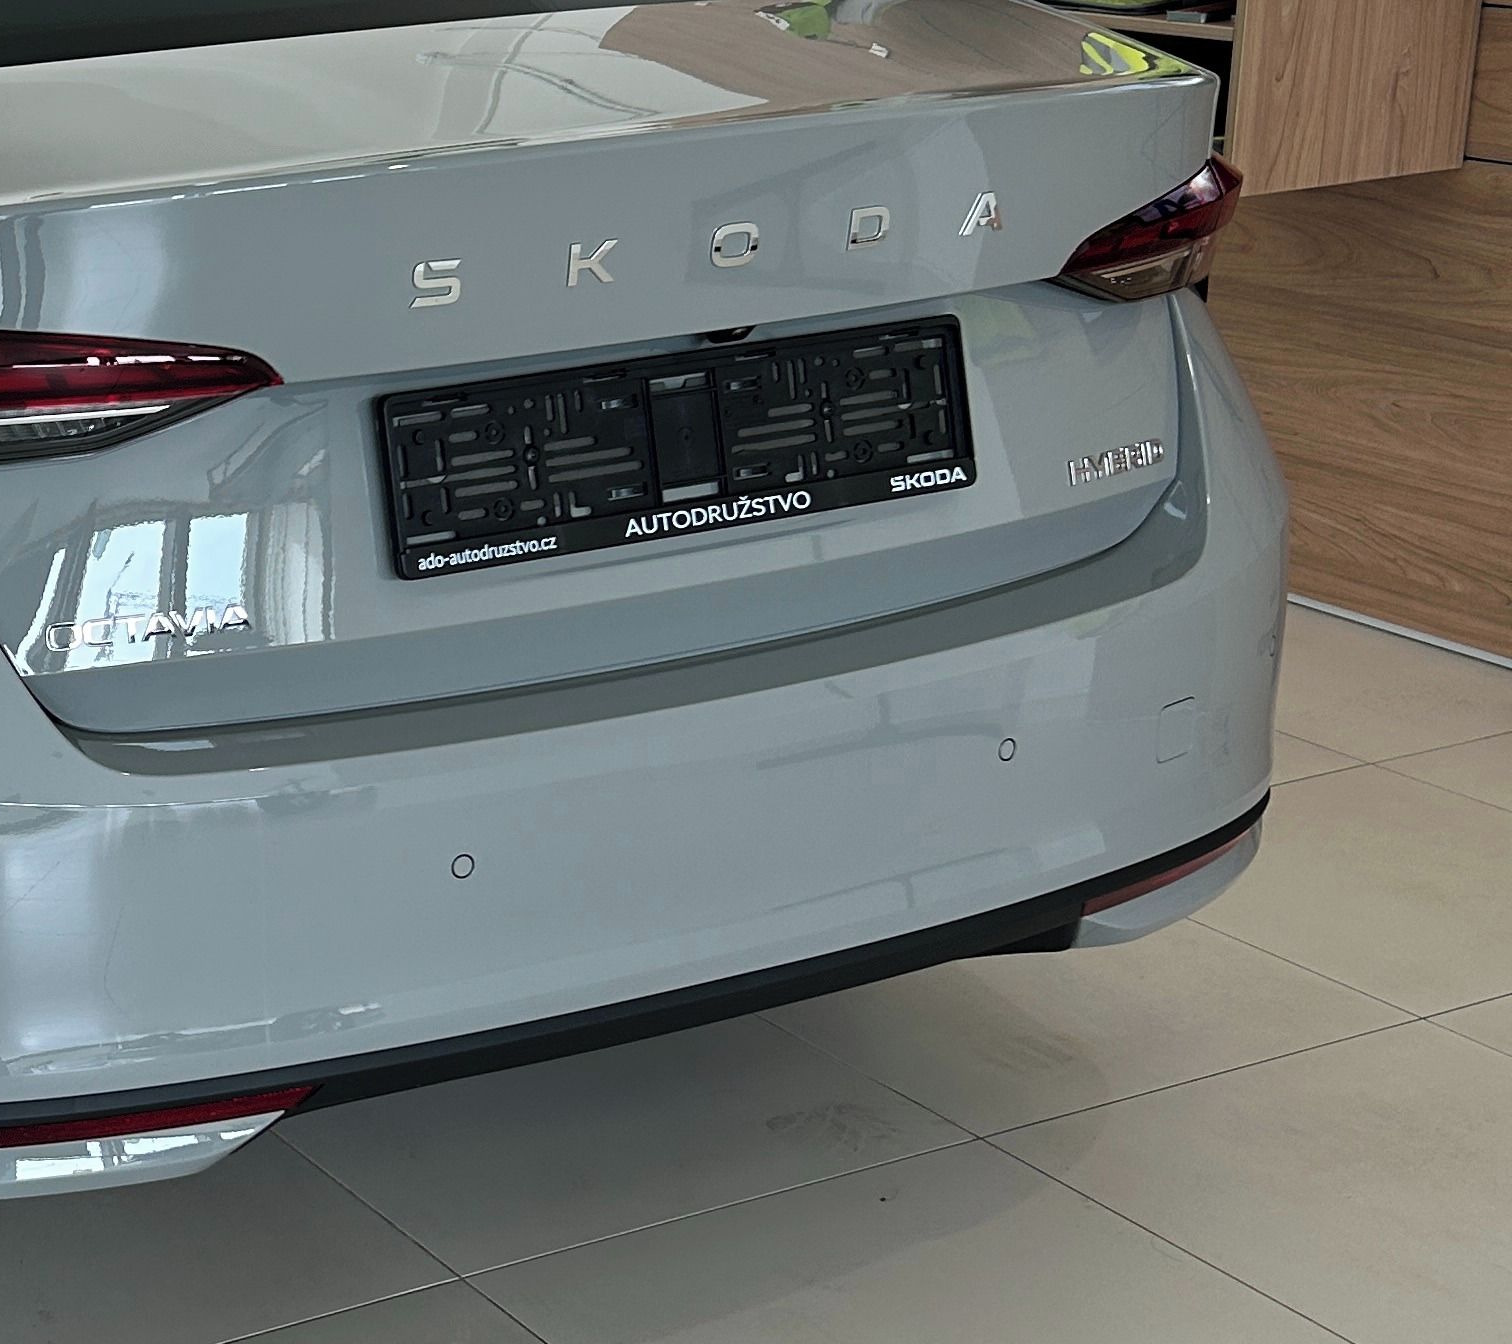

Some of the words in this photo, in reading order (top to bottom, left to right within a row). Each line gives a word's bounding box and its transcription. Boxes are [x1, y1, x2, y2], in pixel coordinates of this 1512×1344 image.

[1068, 438, 1165, 487] HYBRID
[417, 536, 558, 571] ado-autodruzstvo.cz
[624, 490, 812, 538] AUTODRUŽSTVO
[45, 602, 252, 653] OCTAVIA
